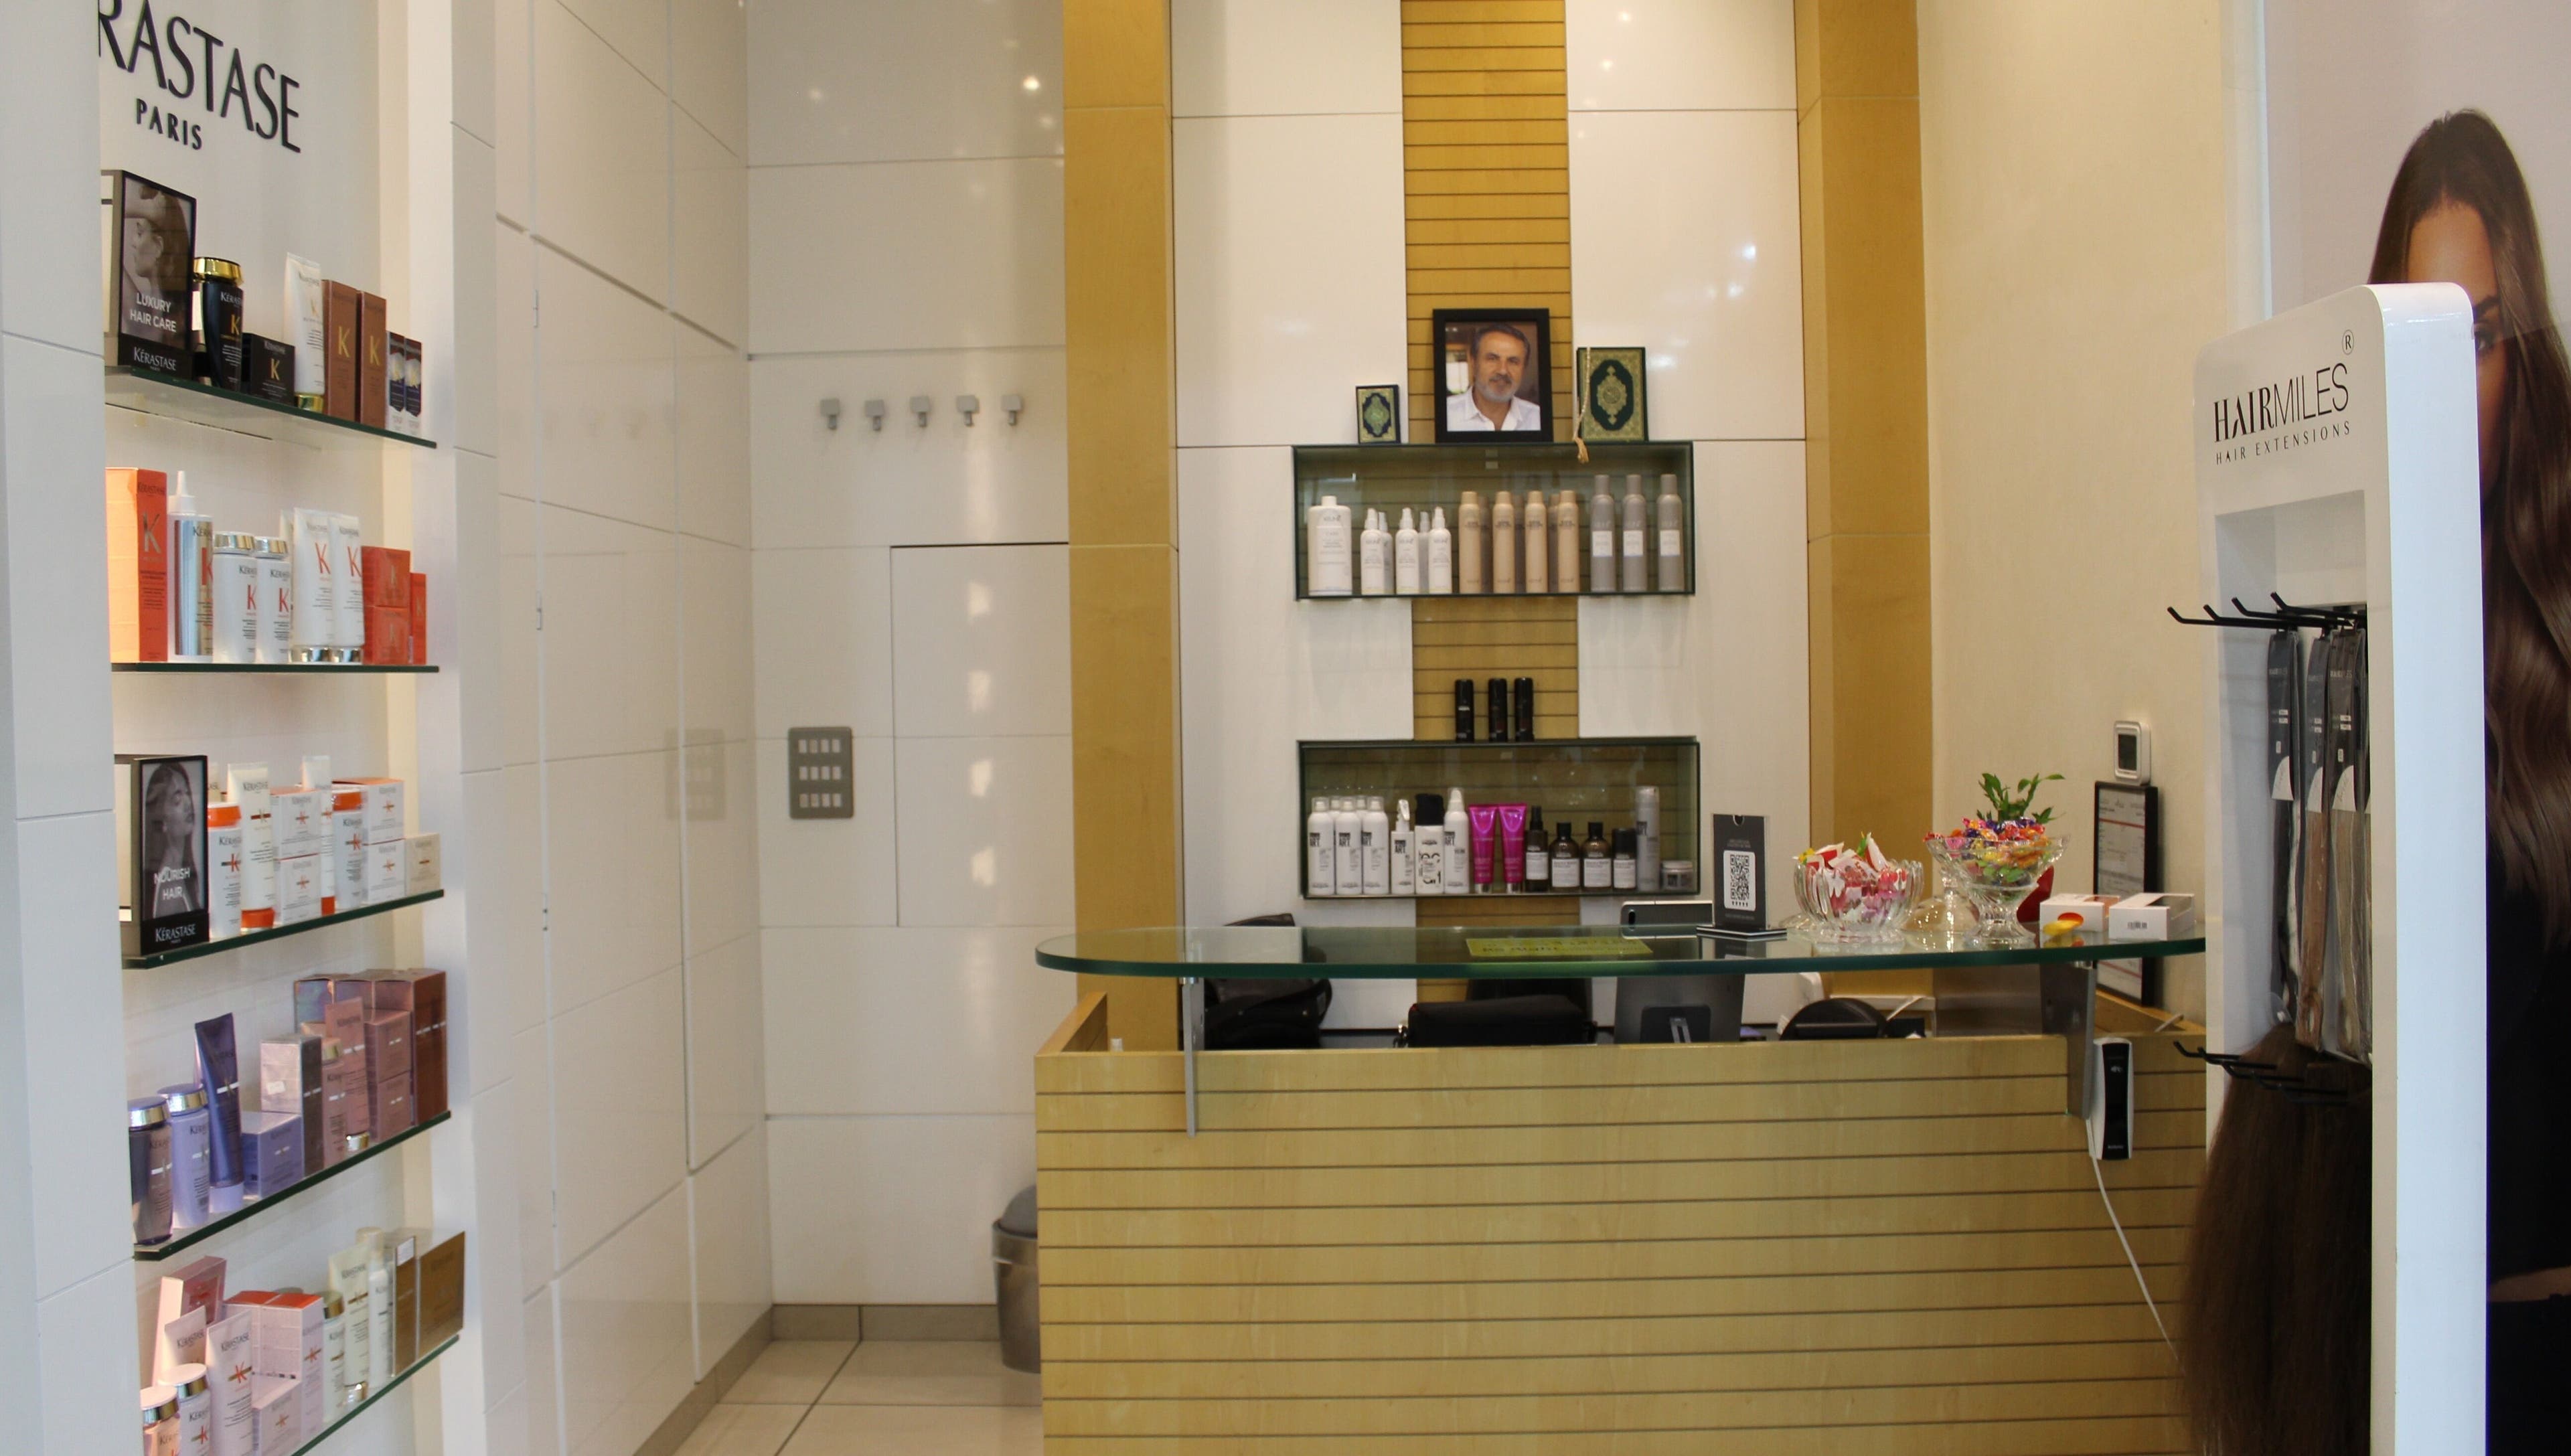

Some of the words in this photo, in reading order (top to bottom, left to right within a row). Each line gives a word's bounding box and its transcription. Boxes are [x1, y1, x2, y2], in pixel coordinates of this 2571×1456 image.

[136, 98, 202, 150] PARIS
[137, 293, 171, 313] LUXURY
[130, 309, 152, 326] HAIR
[153, 316, 177, 333] CARE
[134, 346, 177, 371] KÉRASTASE
[2213, 363, 2349, 442] HAIRMILES
[2216, 447, 2246, 465] HAIR
[2256, 420, 2350, 456] EXTENSIONS
[154, 866, 191, 884] NOURISH
[163, 886, 182, 900] HAIR
